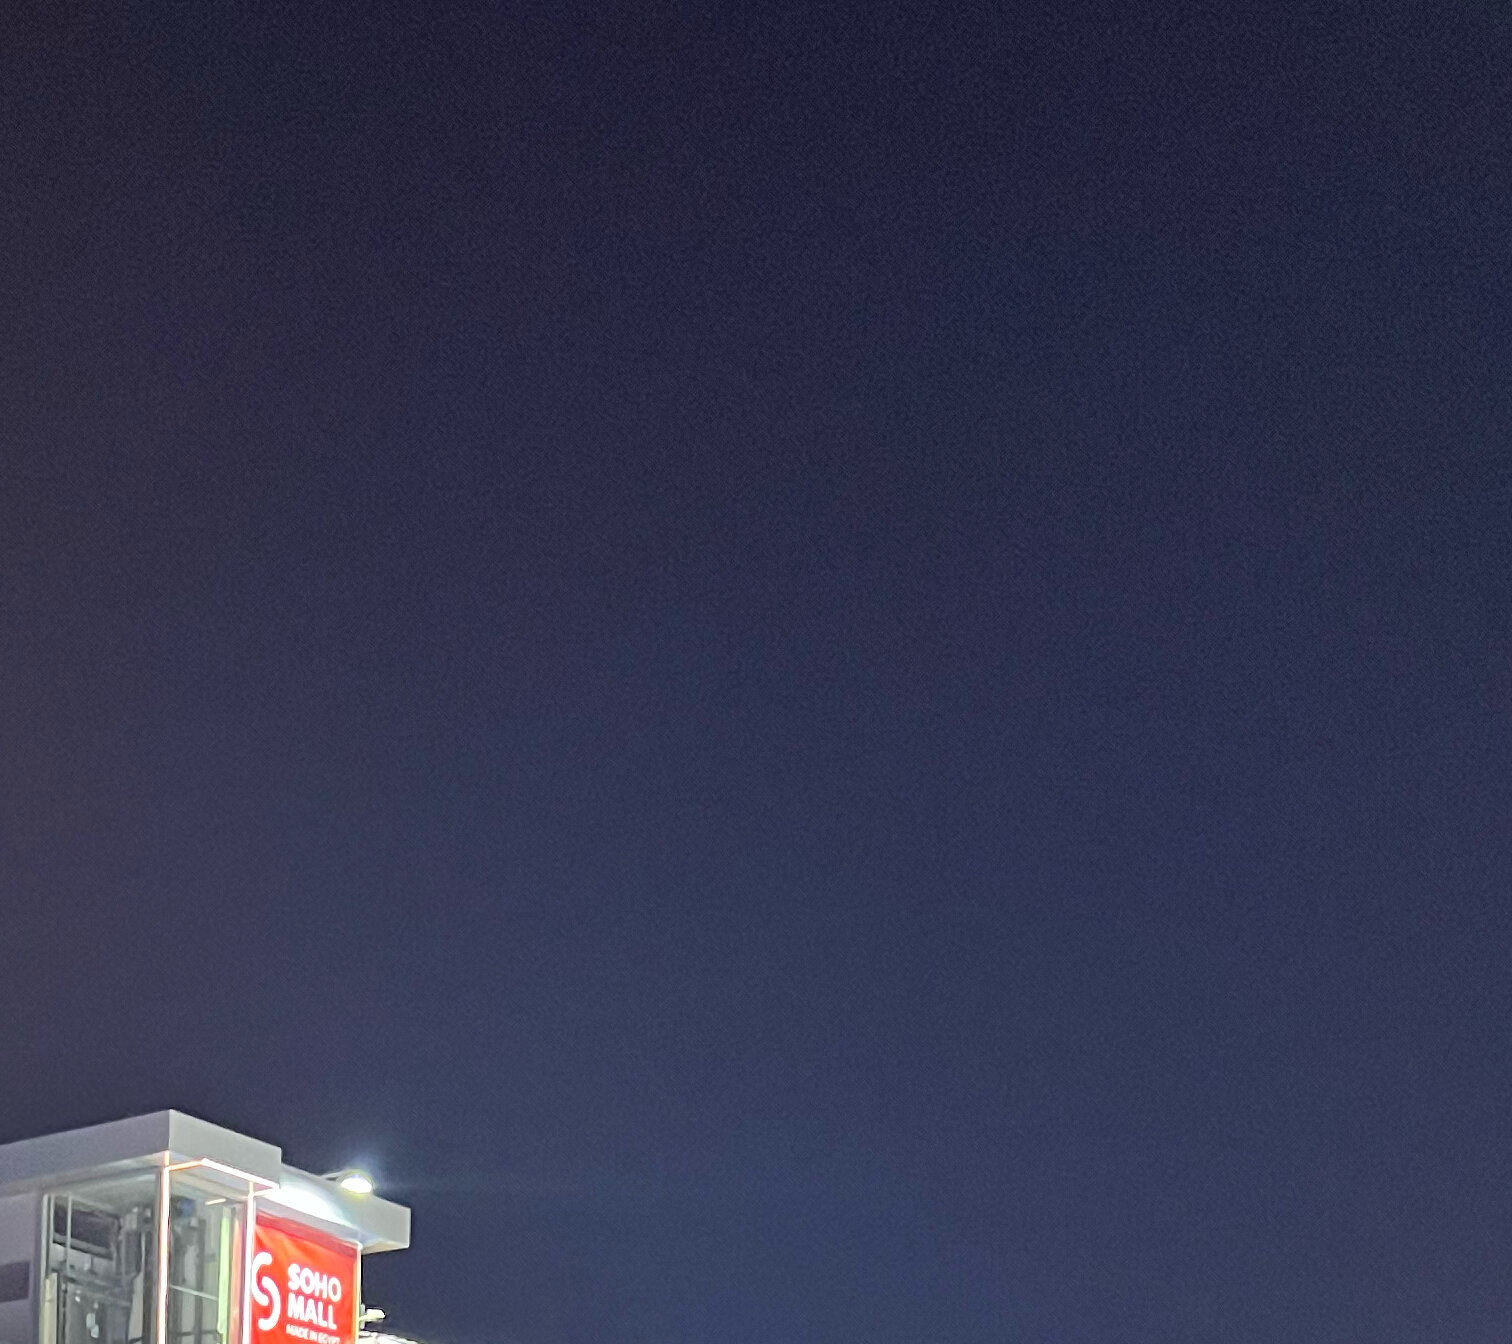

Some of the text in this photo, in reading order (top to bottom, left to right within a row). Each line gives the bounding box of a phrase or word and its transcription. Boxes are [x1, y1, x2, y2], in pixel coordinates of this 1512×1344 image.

[288, 1263, 342, 1302] SOHO
[287, 1293, 337, 1330] MALL
[286, 1324, 309, 1340] MADE
